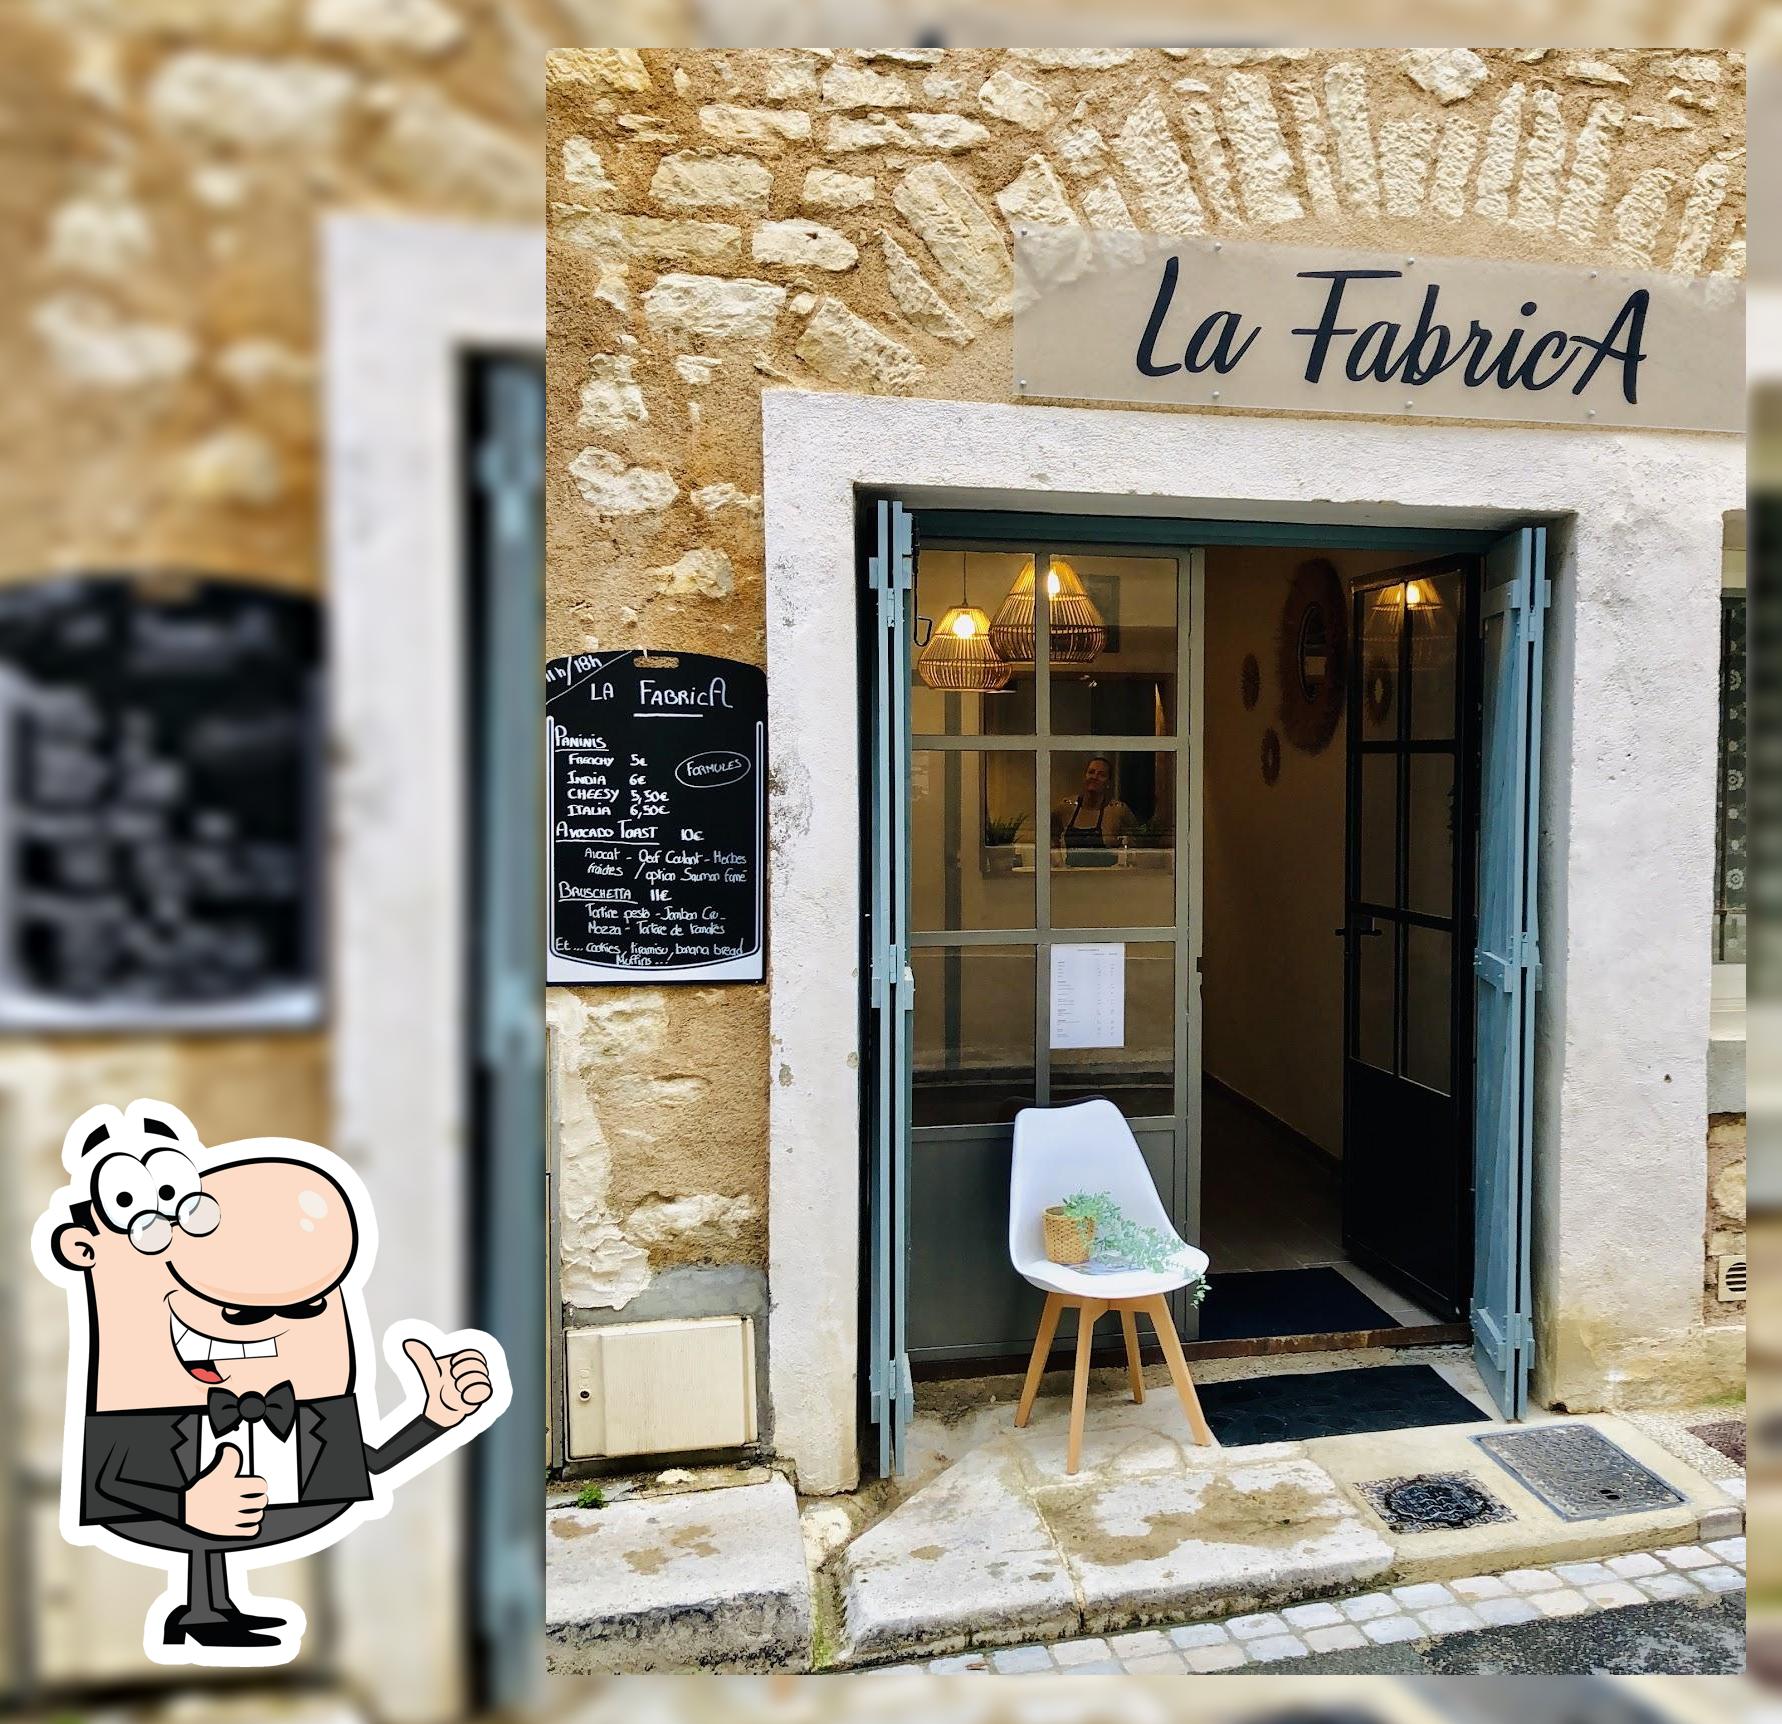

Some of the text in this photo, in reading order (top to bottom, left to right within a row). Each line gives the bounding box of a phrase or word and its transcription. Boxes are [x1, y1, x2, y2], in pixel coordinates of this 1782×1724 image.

[1136, 256, 1650, 404] La FabricA
[591, 682, 614, 700] LA
[629, 774, 647, 785] 6€
[567, 789, 670, 804] CHEESY 5,50€
[630, 804, 670, 819] 6,50€
[645, 868, 676, 885] option
[670, 924, 684, 936] de
[675, 943, 709, 955] banana
